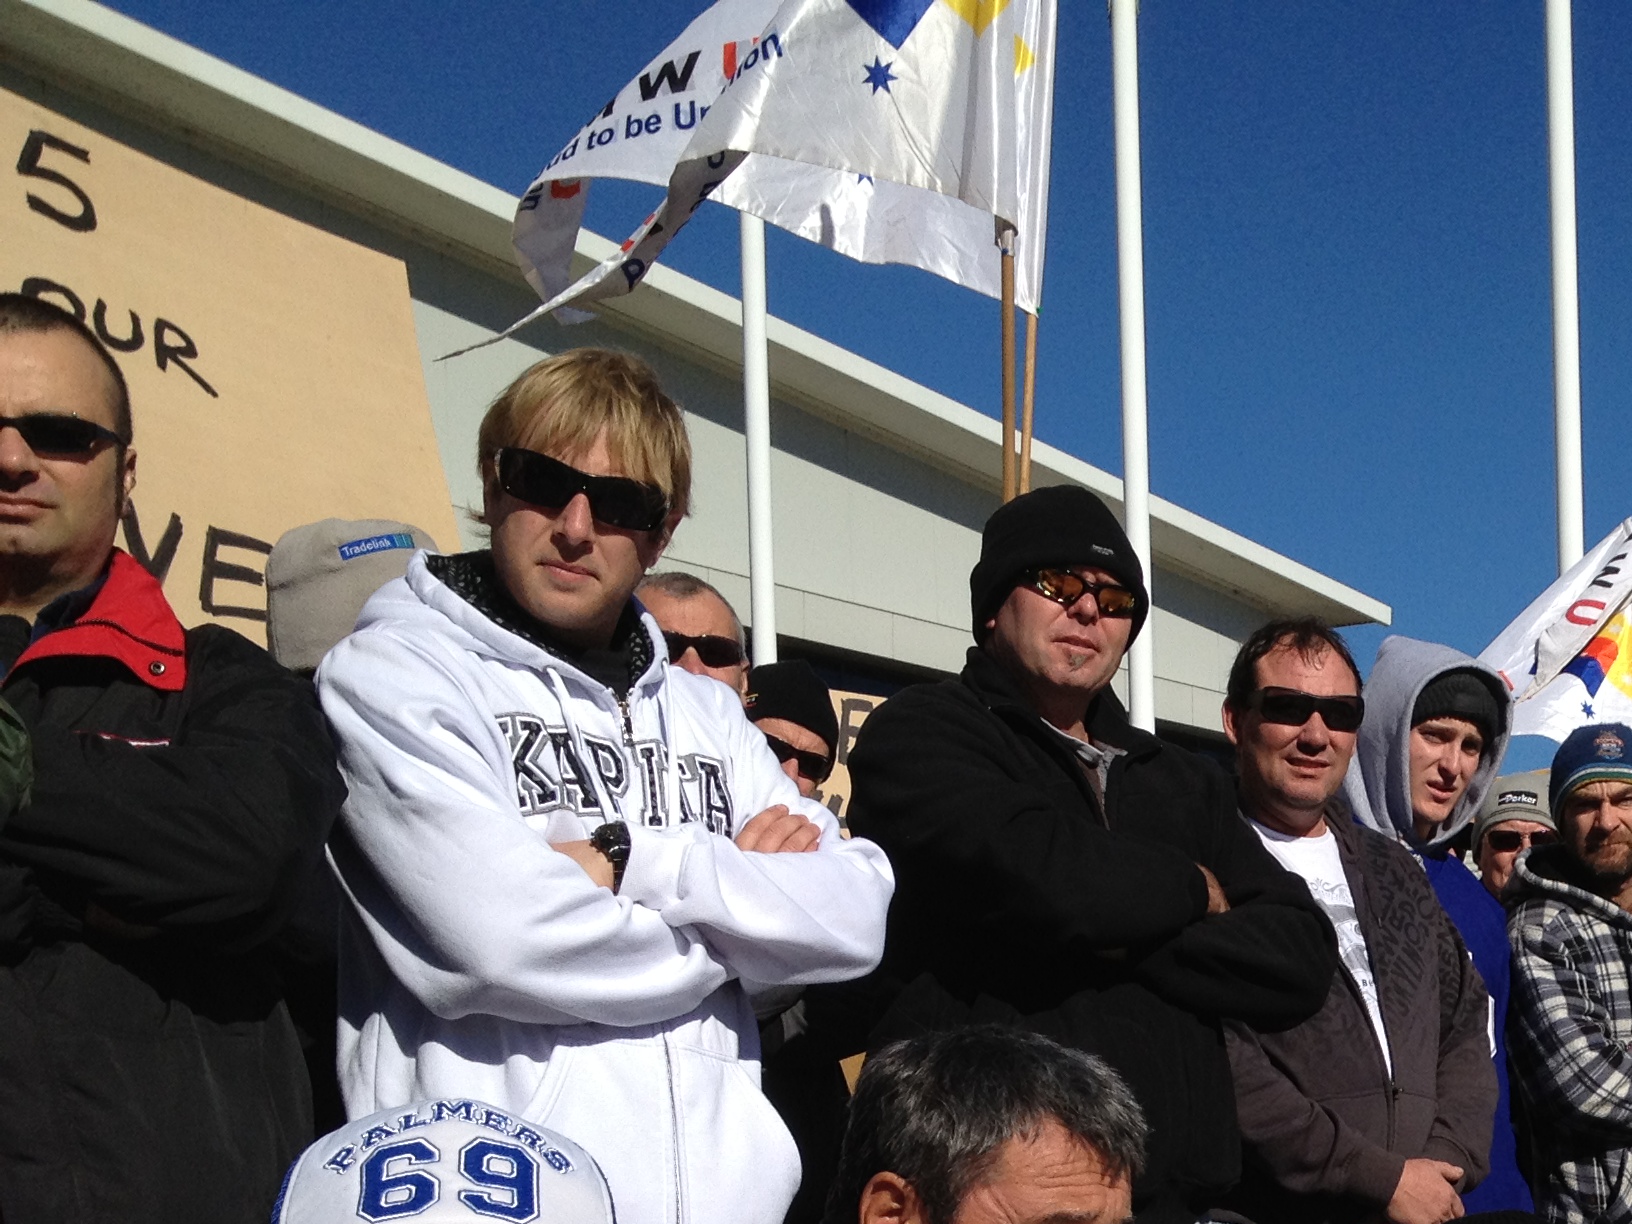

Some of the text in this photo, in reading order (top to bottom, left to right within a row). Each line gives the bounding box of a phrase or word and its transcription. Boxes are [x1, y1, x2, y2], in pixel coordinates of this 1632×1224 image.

[587, 126, 614, 149] to
[625, 113, 661, 139] be
[16, 130, 98, 232] 5
[1504, 793, 1537, 804] Parker
[323, 1100, 575, 1176] PALMERS
